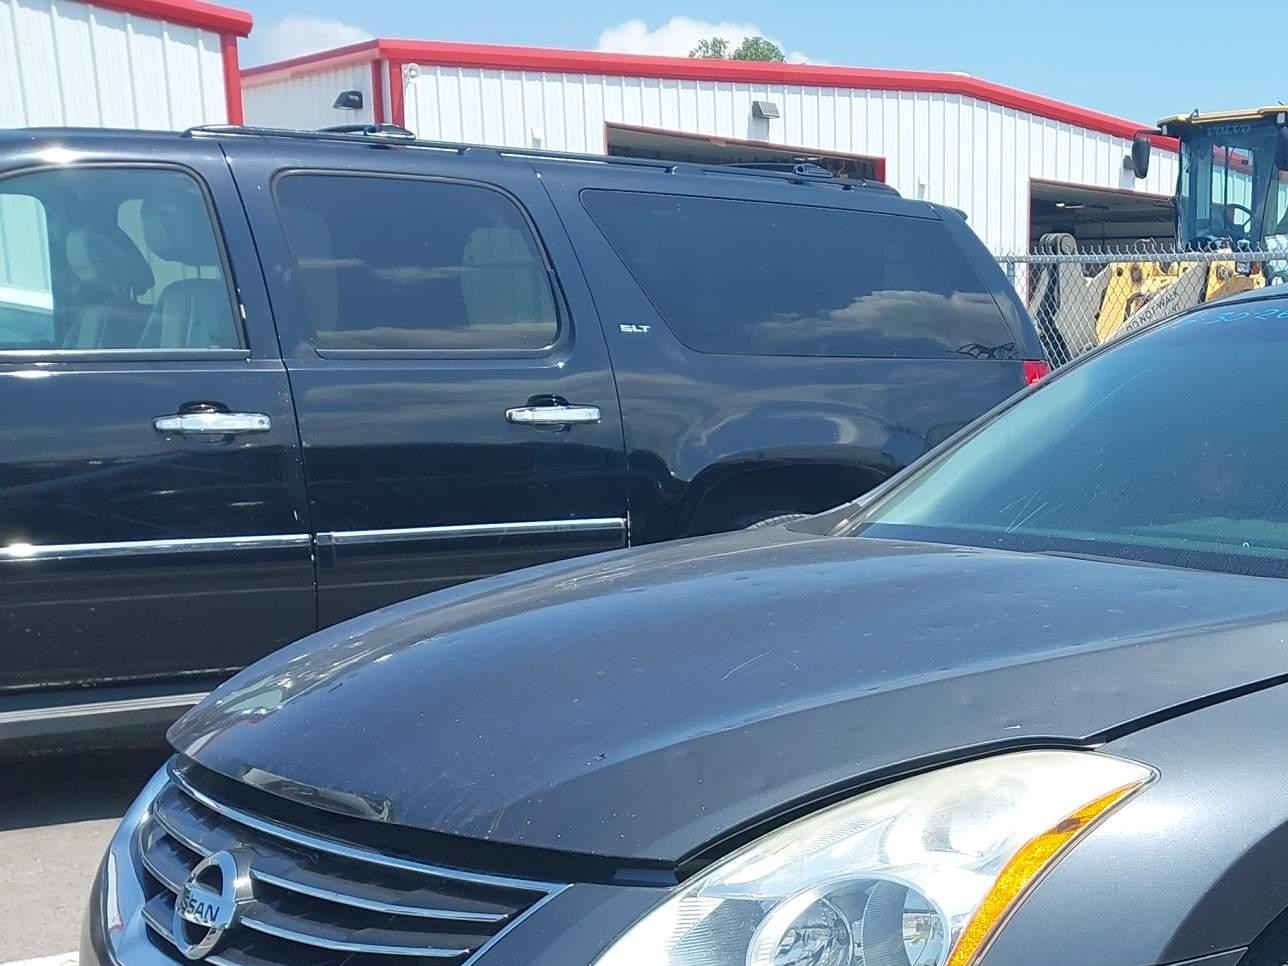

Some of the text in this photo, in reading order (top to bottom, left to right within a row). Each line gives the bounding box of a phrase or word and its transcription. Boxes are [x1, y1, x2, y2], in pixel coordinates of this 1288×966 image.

[1207, 125, 1250, 136] VOLVO
[1157, 291, 1179, 310] WALK
[619, 324, 650, 333] SLT
[178, 891, 220, 922] SSAN
